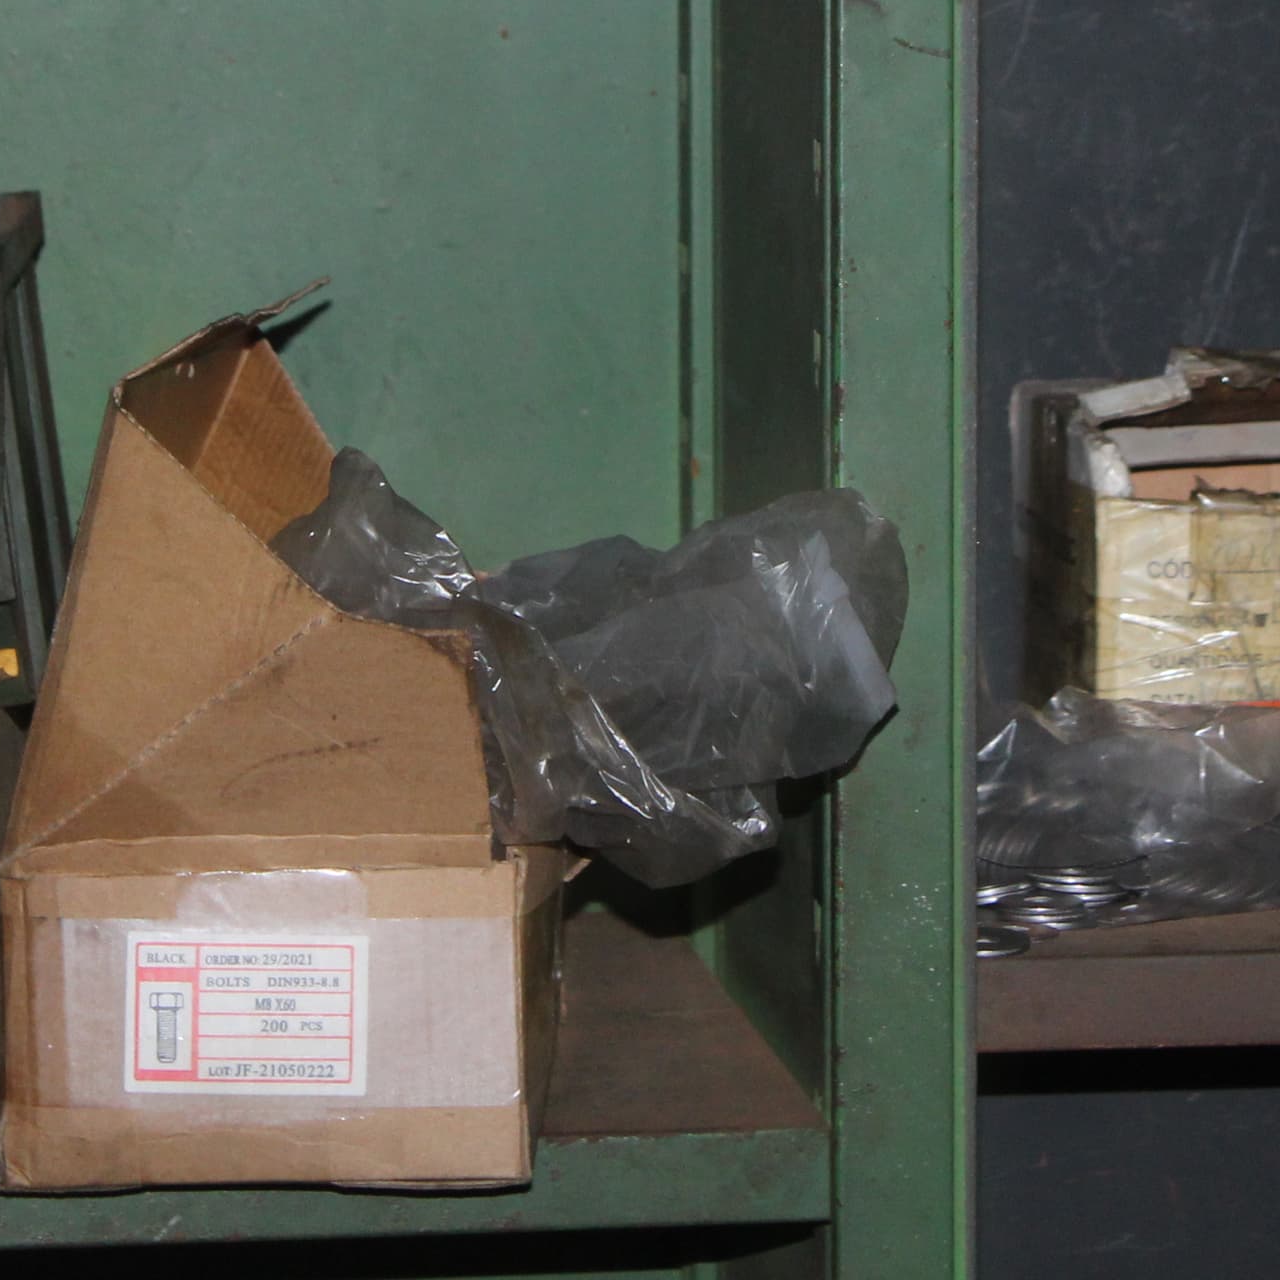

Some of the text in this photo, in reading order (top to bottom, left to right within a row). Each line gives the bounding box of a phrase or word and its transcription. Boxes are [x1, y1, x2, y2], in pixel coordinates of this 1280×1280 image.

[146, 952, 187, 965] BLACK
[204, 954, 241, 966] ORDER
[262, 953, 313, 967] 29/2021
[205, 976, 340, 988] BOLTS DIN933-8.8
[260, 1019, 324, 1033] 200 PCS
[234, 1064, 336, 1079] JF-21050222
